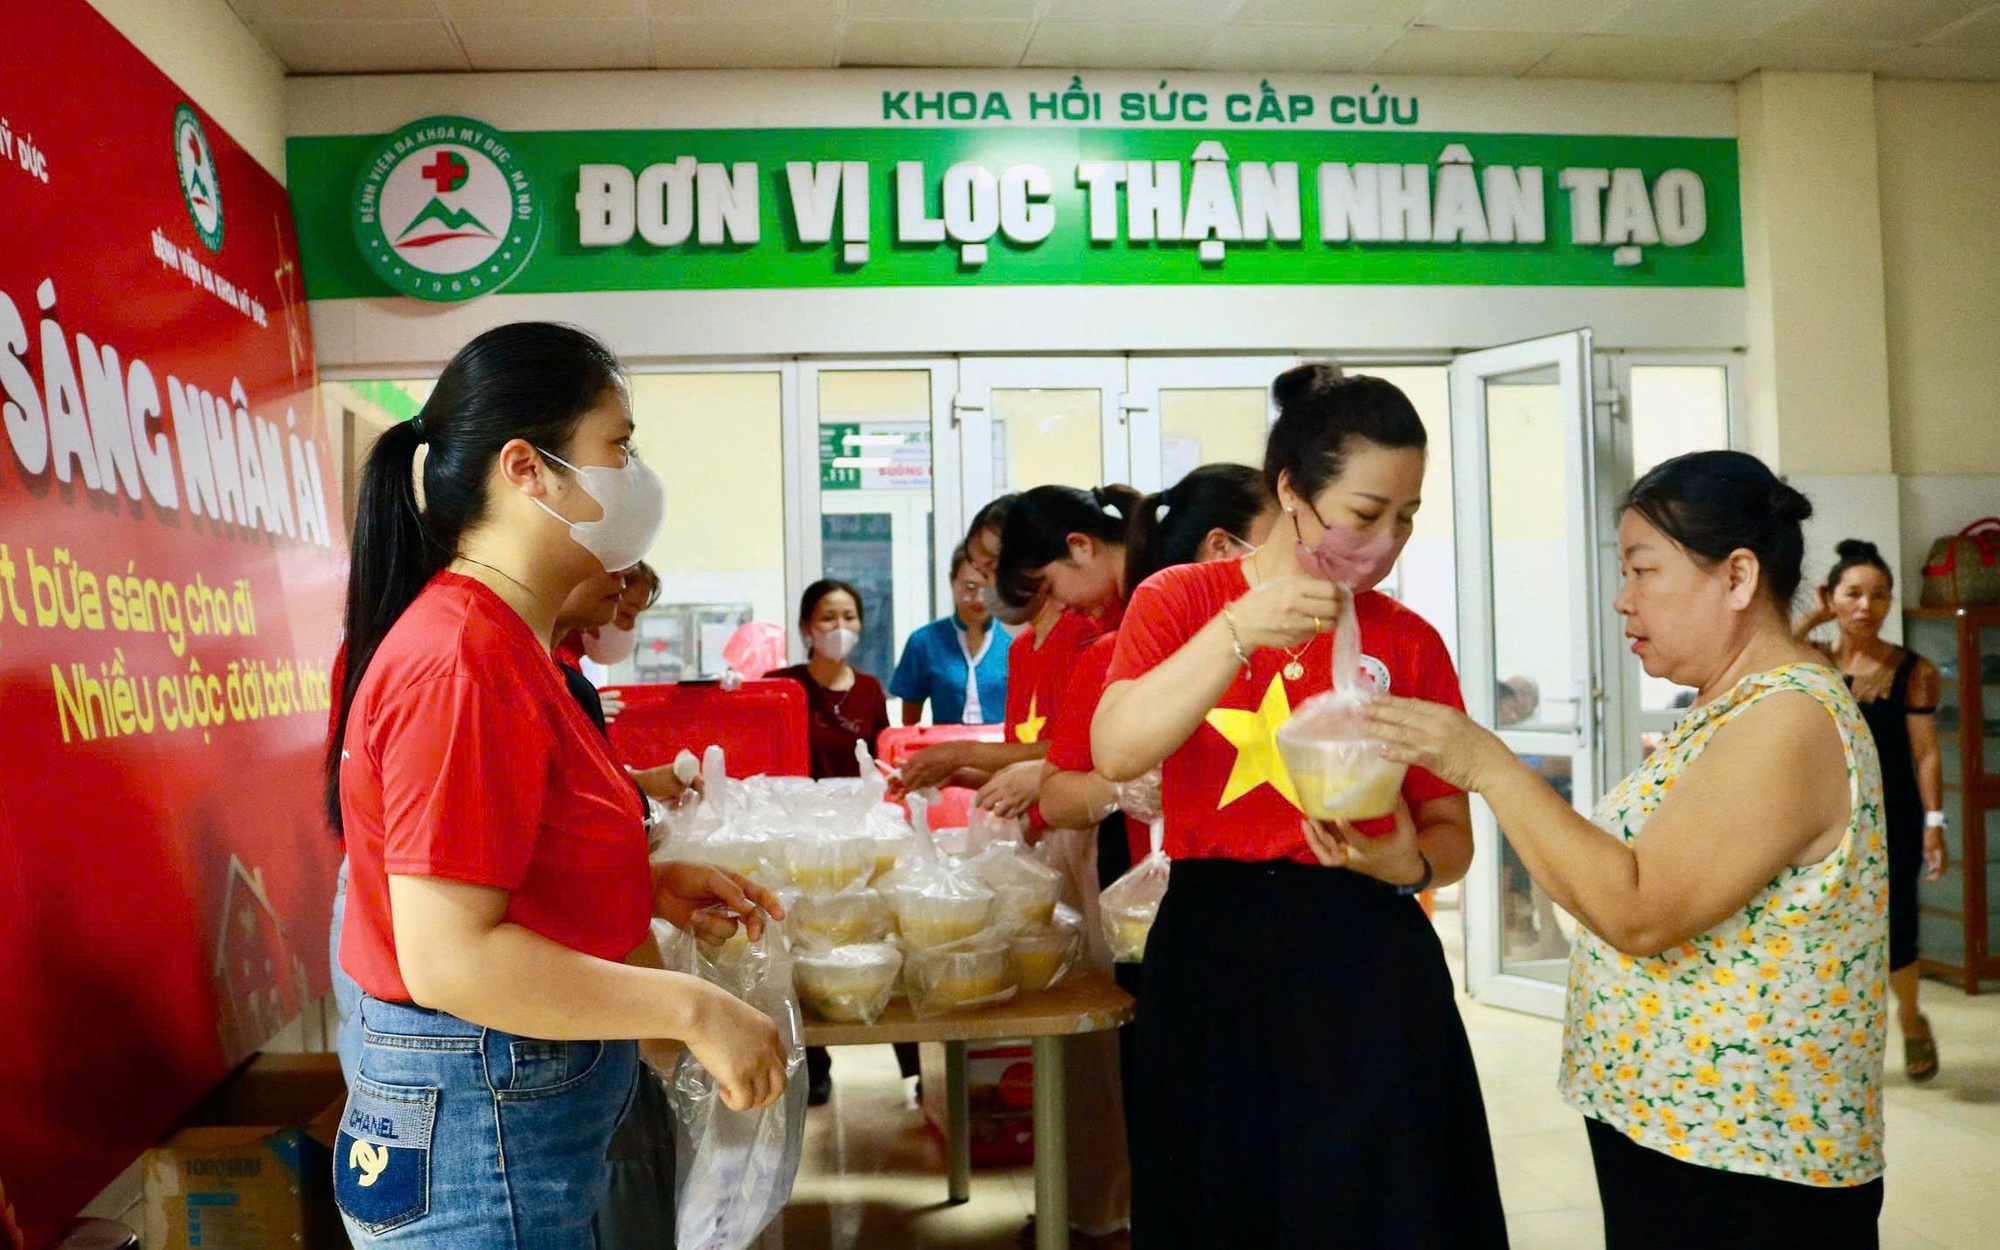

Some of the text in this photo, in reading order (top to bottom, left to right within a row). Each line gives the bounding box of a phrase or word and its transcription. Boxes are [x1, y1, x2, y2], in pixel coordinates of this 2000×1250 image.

[416, 126, 455, 143] KHOA
[883, 91, 1011, 120] KHOA
[1120, 79, 1208, 121] SỨC
[1330, 83, 1418, 125] CỨU
[576, 140, 1707, 266] ĐƠN VỊ LỌC THẬN NHÂN TẠO
[0, 277, 331, 548] SÁNG NHÂN ÁI
[26, 547, 105, 630] bữa
[107, 560, 185, 657] sáng
[185, 572, 233, 636] cho
[233, 578, 256, 635] đi
[51, 647, 154, 743] Nhiều
[158, 656, 225, 745] cuộc
[350, 1108, 399, 1139] CHANEL
